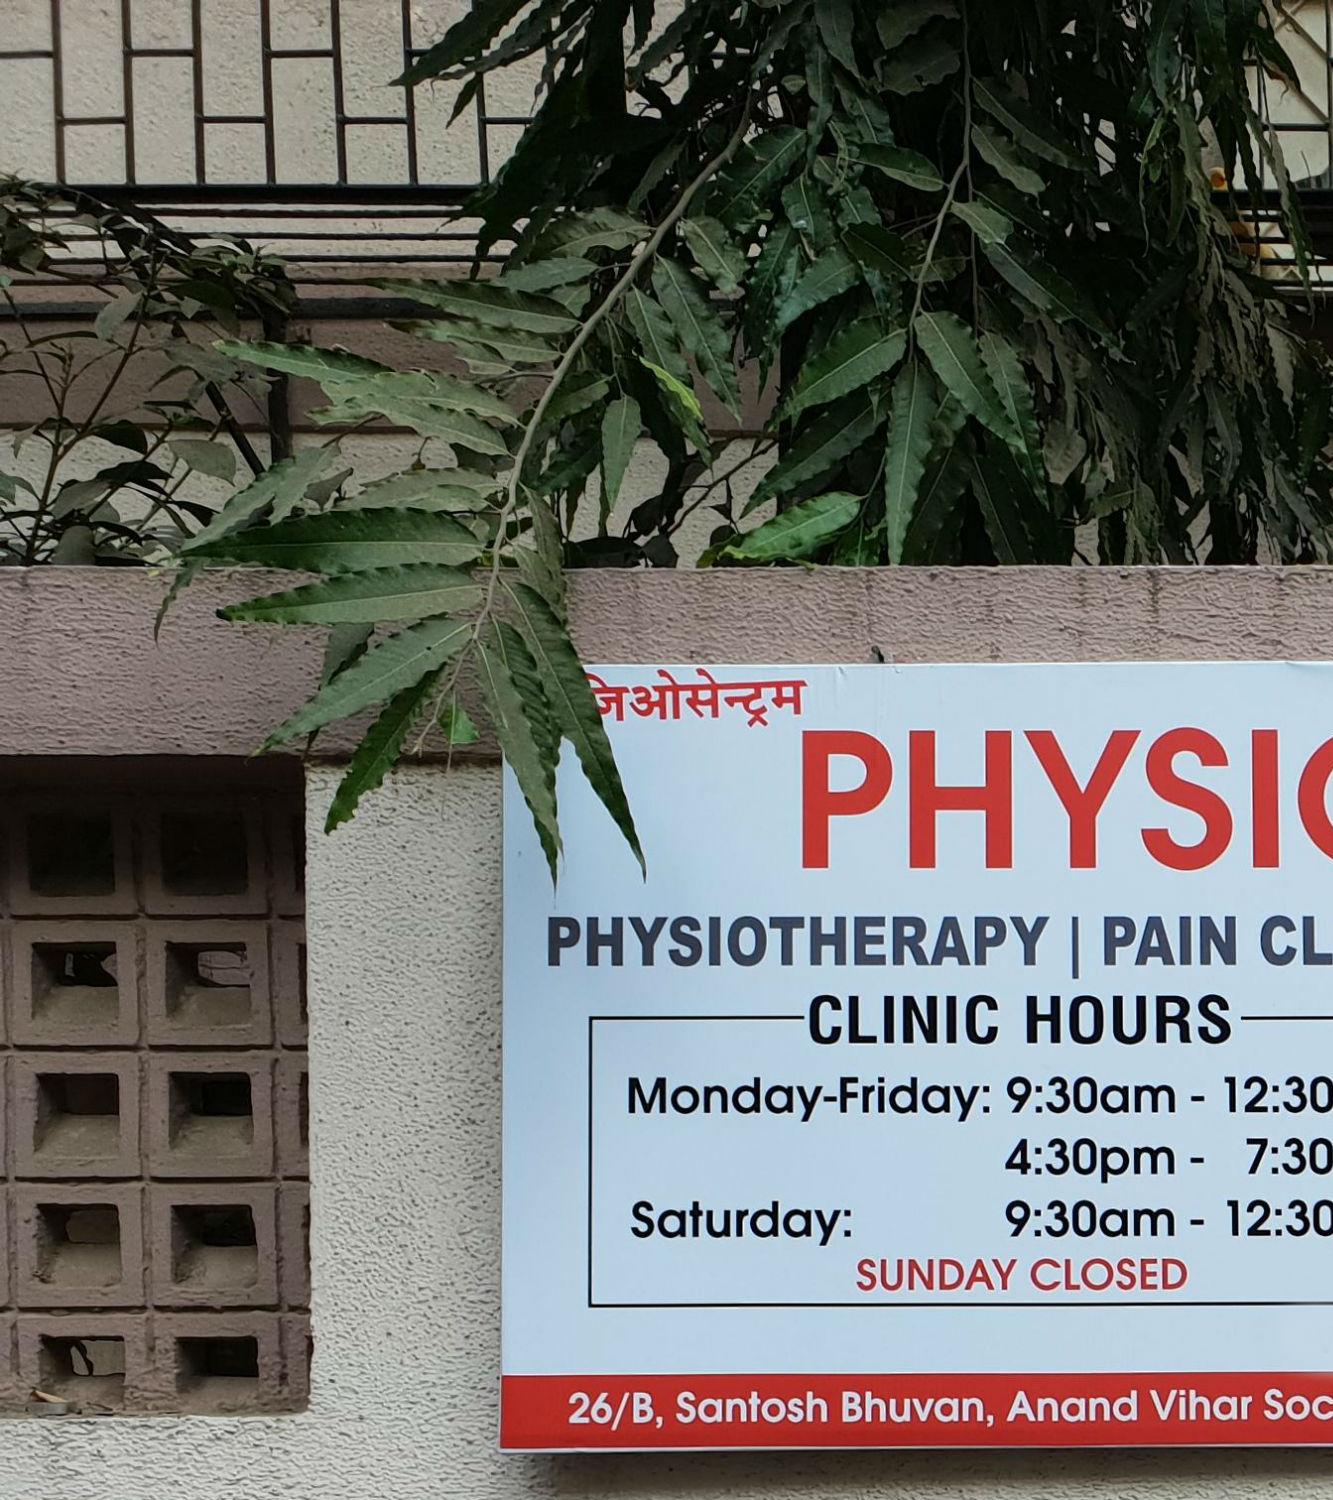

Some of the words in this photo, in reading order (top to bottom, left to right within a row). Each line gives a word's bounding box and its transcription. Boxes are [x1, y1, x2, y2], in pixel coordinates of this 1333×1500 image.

[548, 916, 1049, 966] PHYSIOTHERAPY
[1104, 916, 1236, 965] PAIN
[810, 995, 998, 1044] CLINIC
[1027, 994, 1231, 1045] HOURS
[629, 1077, 989, 1122] Monday-Friday:
[1007, 1076, 1175, 1113] 9:30am
[1005, 1138, 1174, 1183] 4:30pm
[631, 1201, 851, 1246] Saturday:
[1006, 1200, 1174, 1237] 9:30am
[859, 1260, 1015, 1291] SUNDAY
[1032, 1260, 1187, 1290] CLOSED
[569, 1392, 662, 1430] 26/B,
[676, 1392, 827, 1423] Santosh
[842, 1392, 993, 1426] Bhuvan,
[1007, 1390, 1137, 1422] Anand
[1150, 1390, 1252, 1420] Vihar
